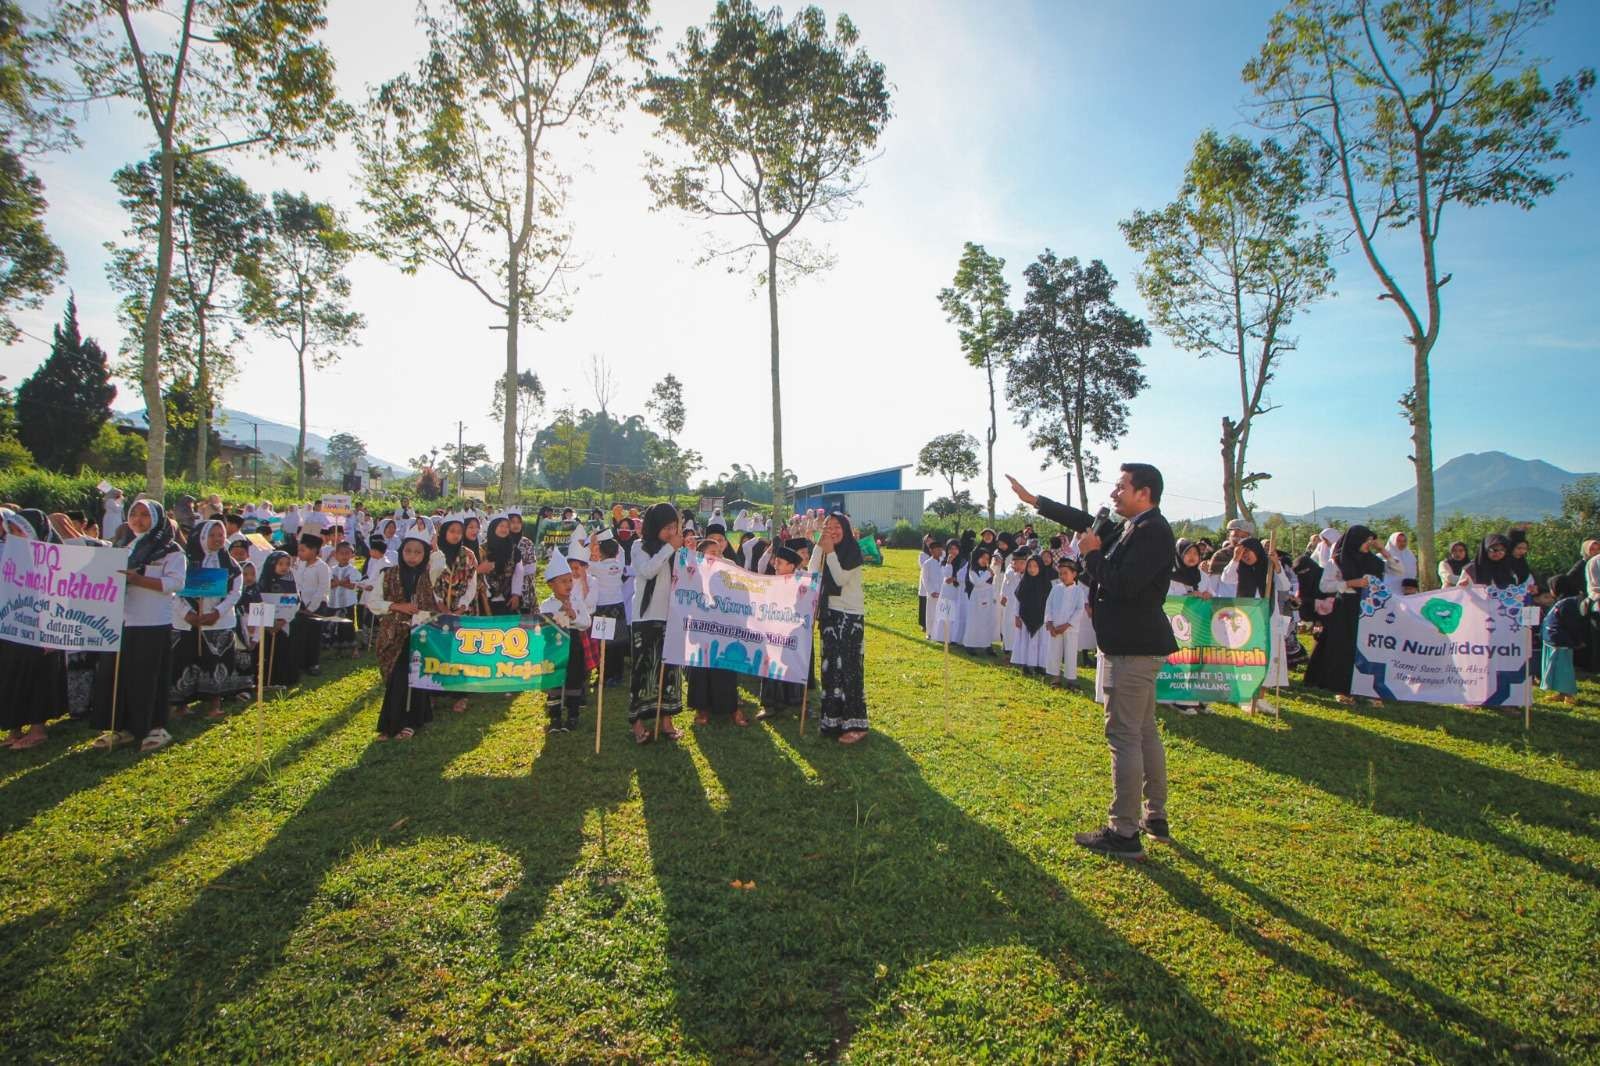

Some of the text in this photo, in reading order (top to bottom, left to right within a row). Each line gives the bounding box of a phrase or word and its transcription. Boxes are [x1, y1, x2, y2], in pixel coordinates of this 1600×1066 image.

[456, 627, 529, 659] TPQ
[1367, 633, 1521, 659] RTQ Nurul Hidayah
